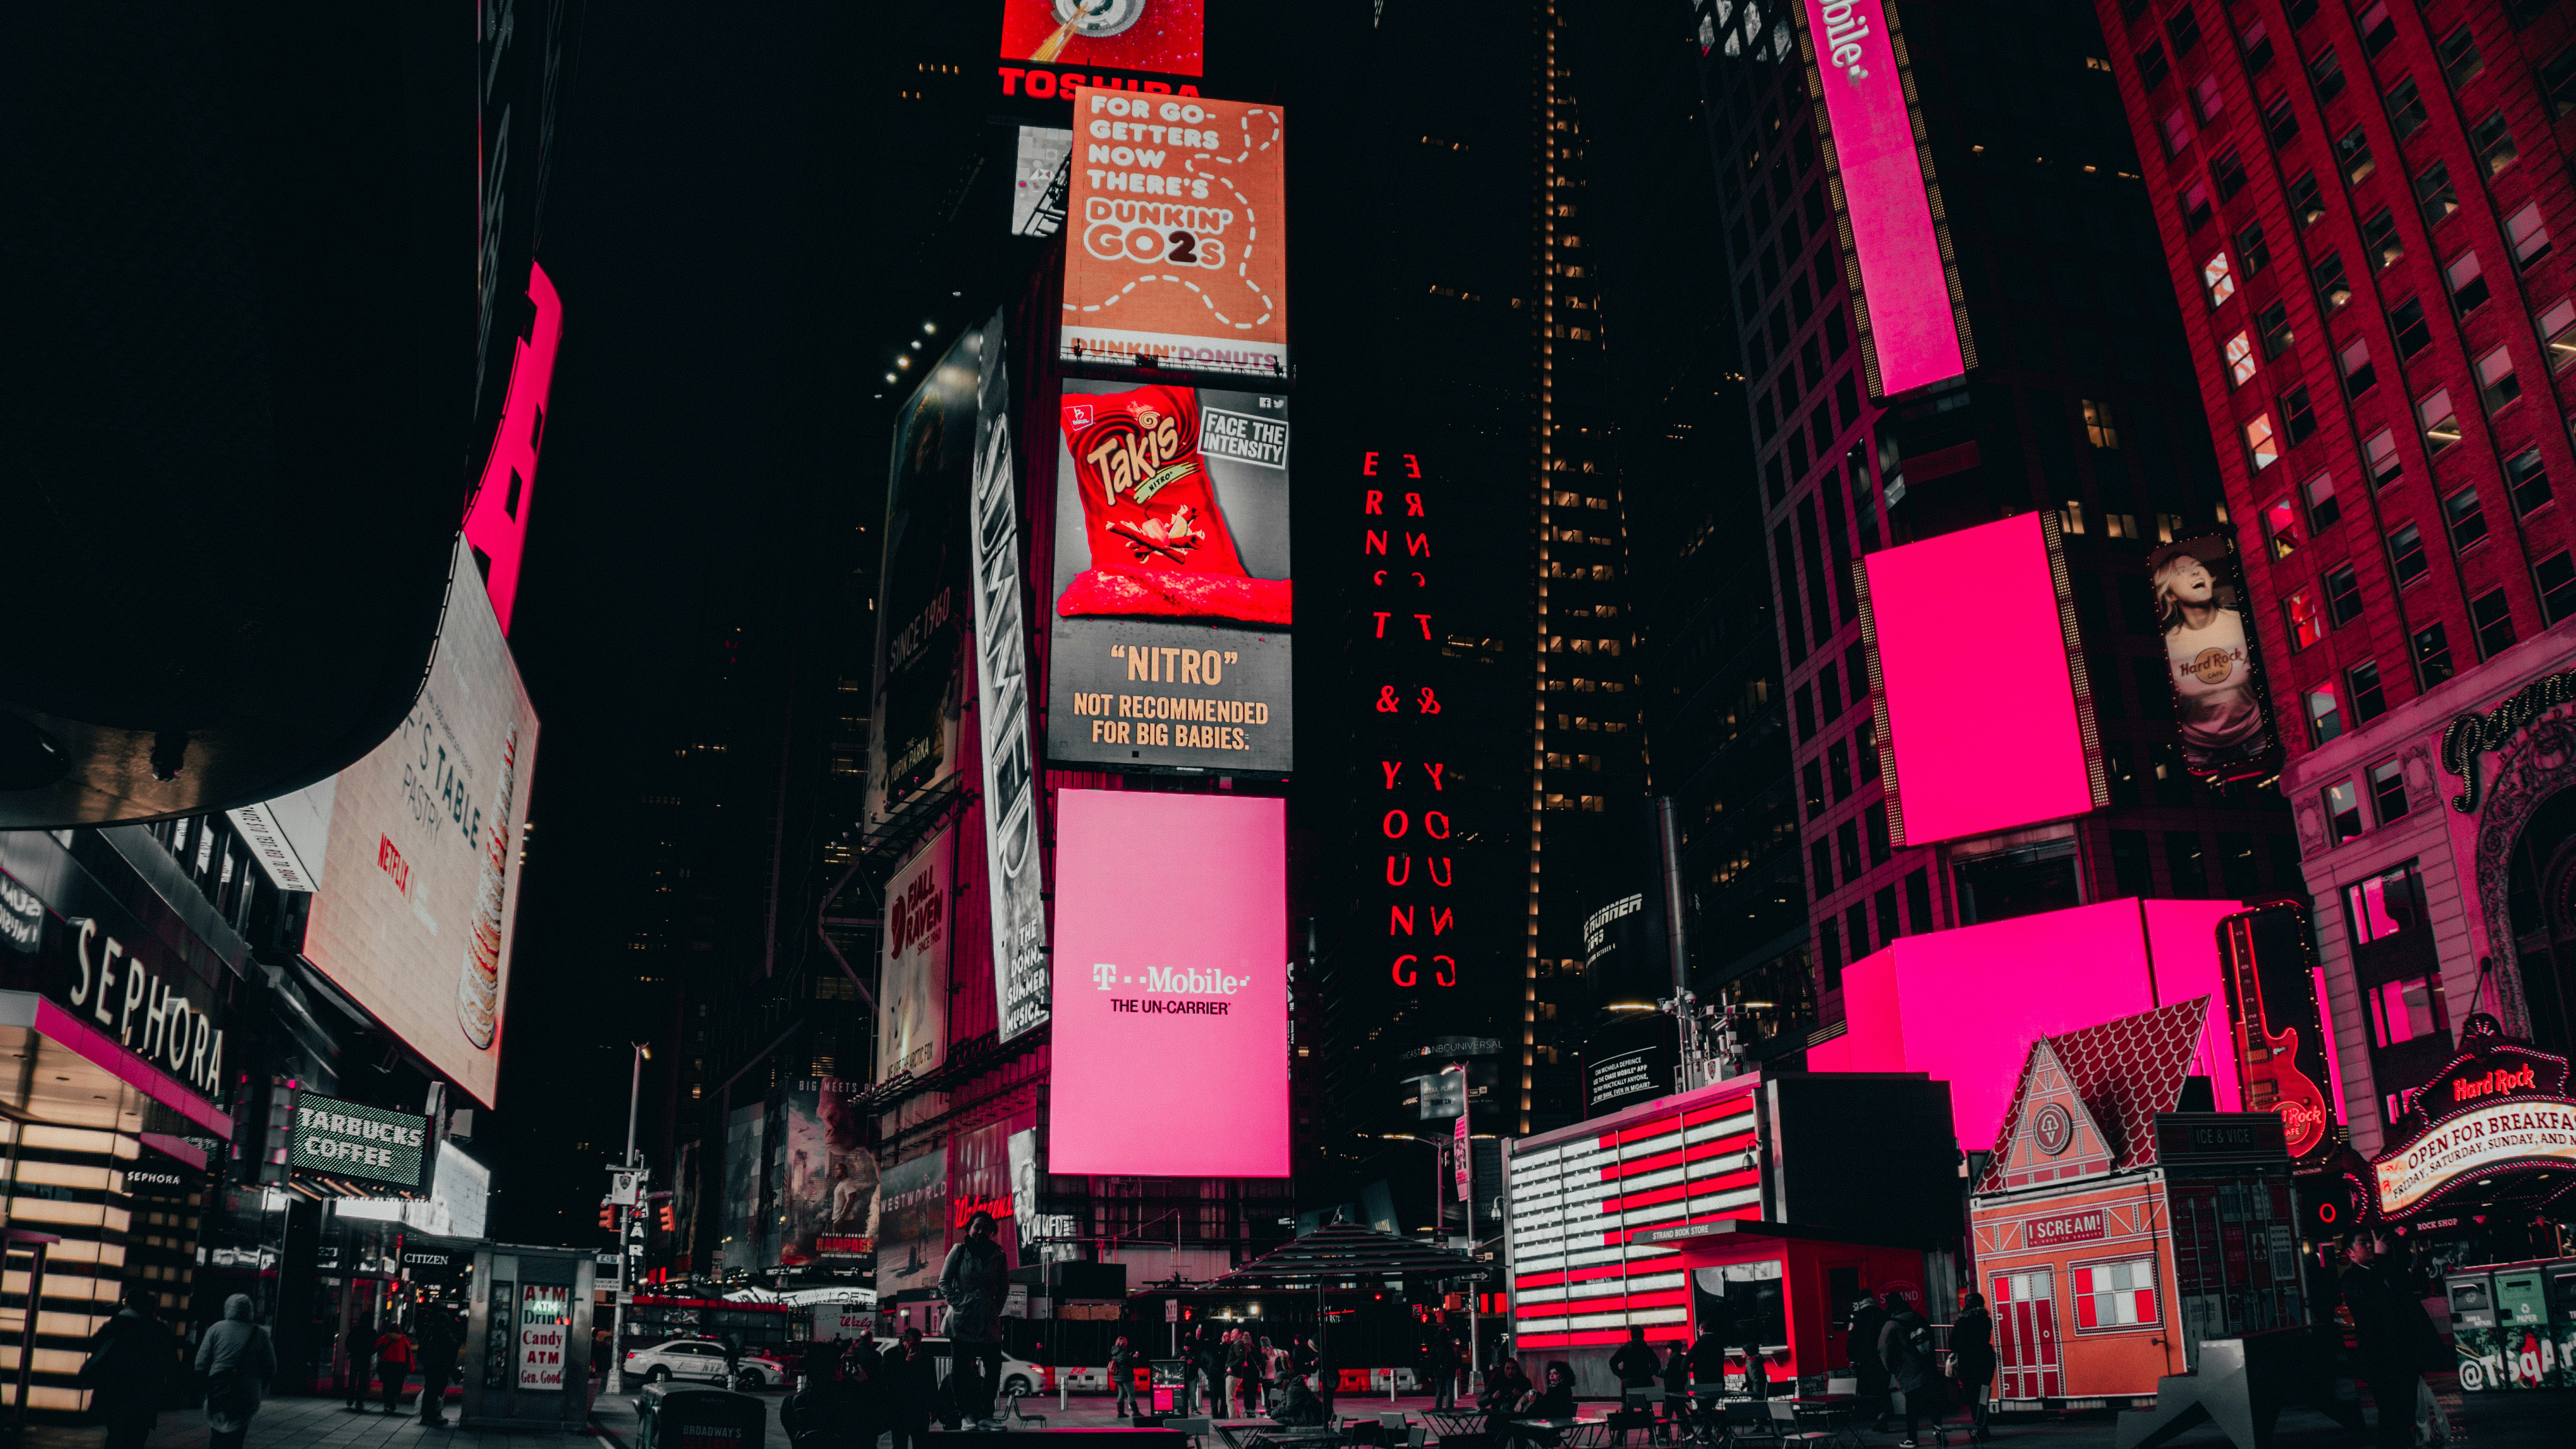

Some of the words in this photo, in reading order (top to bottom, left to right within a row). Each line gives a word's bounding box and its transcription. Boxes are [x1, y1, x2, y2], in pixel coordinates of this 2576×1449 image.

[1819, 0, 1869, 69] bile
[1091, 95, 1149, 118] FOR
[1159, 101, 1216, 124] GO-
[1090, 120, 1219, 150] GETTERS
[1088, 144, 1166, 169] NOW
[1087, 170, 1209, 199] THERE'S
[1088, 198, 1232, 232] DUNKIN'
[1086, 222, 1225, 269] GO2S
[1071, 337, 1177, 360] DUNKIN'
[1179, 346, 1279, 369] DONUTS
[1206, 413, 1248, 437] FACE
[1252, 422, 1285, 445] THE
[1203, 433, 1283, 462] INTENSITY
[1087, 417, 1179, 506] Takis
[1148, 474, 1170, 491] NITRO
[890, 614, 921, 673] SINCE
[924, 585, 951, 640] 1960
[2180, 656, 2210, 676] Hard
[2213, 648, 2244, 667] Rock
[1074, 692, 1113, 716] NOT
[1118, 695, 1269, 724] RECOMMENDED
[1092, 720, 1130, 744] FOR
[1136, 722, 1168, 747] BIG
[1175, 724, 1250, 750] BABIES.
[908, 736, 929, 770] PARKA
[402, 763, 442, 846] PASTRY
[436, 743, 480, 851] TABLE
[378, 832, 410, 897] NETFLIX
[1382, 761, 1418, 987] YOUNG
[1589, 893, 1643, 934] RUNNER
[1020, 918, 1037, 941] THE
[1011, 942, 1044, 979] DONNA
[1007, 967, 1045, 1007] SUMMER
[69, 918, 224, 1097] SEPHORA
[1111, 999, 1139, 1012] THE
[1142, 1000, 1229, 1015] UN-CARRIER
[910, 1047, 924, 1070] ARCTIC
[924, 1041, 933, 1060] FOX
[1432, 1040, 1504, 1053] NBCUNIVERSAL
[1601, 1063, 1619, 1073] MICHAELA
[1619, 1057, 1641, 1067] DEPRINCE
[1604, 1072, 1617, 1081] CHASE
[799, 1080, 817, 1091] BIG
[823, 1081, 857, 1093] MEETS
[1603, 1078, 1627, 1090] PRACTICALLY
[1627, 1073, 1649, 1083] ANYONE,
[1630, 1081, 1650, 1091] MIDAIR?
[2453, 1072, 2493, 1101] Hard
[2495, 1063, 2536, 1095] Rock
[2288, 1105, 2322, 1126] Rock
[2196, 1130, 2213, 1143] ICE
[2217, 1130, 2224, 1143] &
[2227, 1129, 2251, 1143] VICE
[2286, 1128, 2300, 1136] AFE
[2409, 1134, 2448, 1170] OPEN
[2451, 1121, 2485, 1146] FOR
[2488, 1112, 2576, 1134] BREAKFA
[305, 1137, 392, 1169] COFFEE
[2393, 1169, 2429, 1199] FRIDAY,
[2430, 1143, 2487, 1173] SATURDAY,
[2488, 1134, 2538, 1150] SUNDAY,
[2540, 1133, 2567, 1145] AND
[128, 1170, 181, 1186] SEPHORA
[881, 1181, 946, 1213] WESTWORLD
[1653, 1231, 1674, 1241] STRAND
[1675, 1228, 1689, 1238] BOOK
[1691, 1225, 1709, 1236] STORE
[2029, 1225, 2033, 1239] I
[2037, 1215, 2100, 1238] SCREAM!
[2417, 1222, 2437, 1231] ROCK
[2438, 1218, 2458, 1228] SHOP
[816, 1237, 873, 1253] RAMPAGE
[404, 1253, 449, 1265] CITIZEN
[524, 1286, 566, 1302] ATM
[533, 1300, 558, 1312] ATM
[829, 1291, 870, 1303] LOFT
[1879, 1290, 1919, 1303] SND
[524, 1310, 564, 1325] Drink
[2516, 1313, 2538, 1323] PAPER
[523, 1331, 562, 1349] Candy
[527, 1351, 559, 1364] ATM
[521, 1370, 538, 1383] Gen.
[683, 1425, 741, 1438] BROADWAY'S
